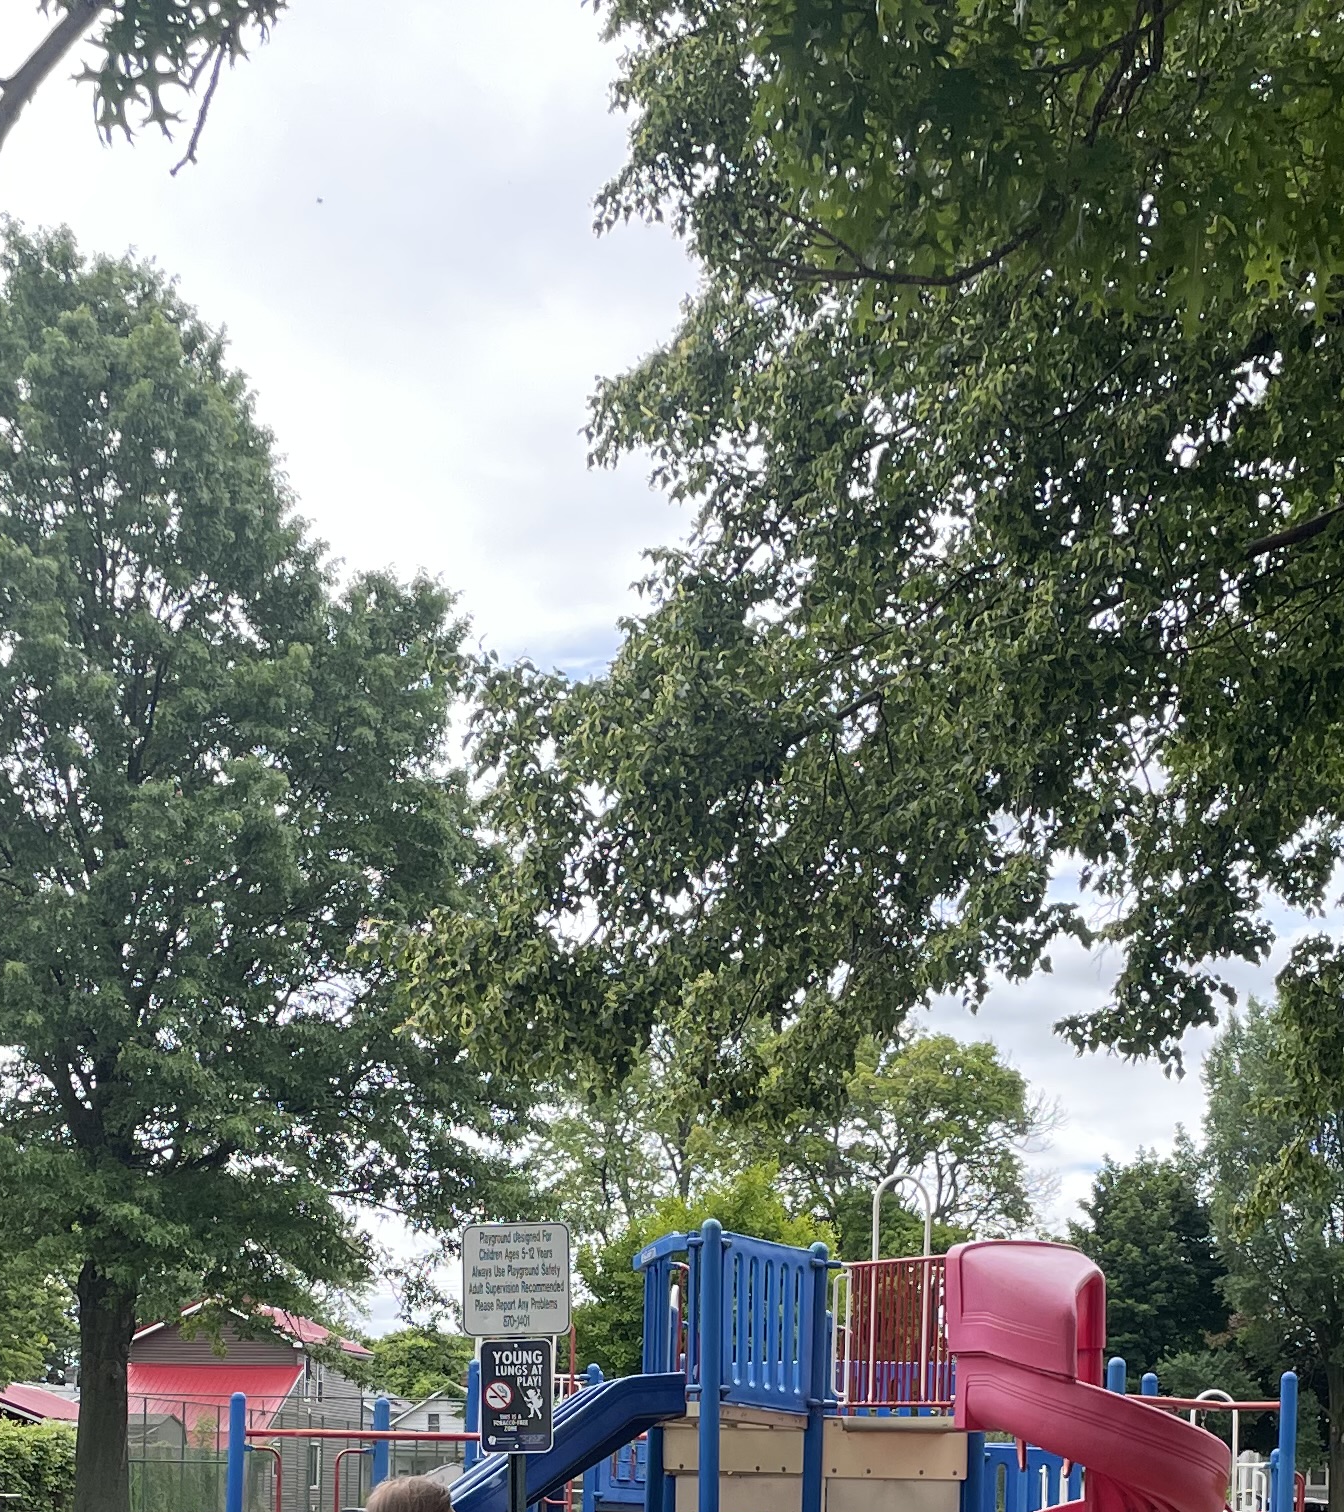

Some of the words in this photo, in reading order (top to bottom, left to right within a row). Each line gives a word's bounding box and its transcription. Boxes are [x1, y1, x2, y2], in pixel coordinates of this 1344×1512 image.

[479, 1231, 511, 1246] Playground
[542, 1230, 552, 1242] For
[479, 1249, 503, 1261] Children
[505, 1248, 520, 1262] Ages
[522, 1247, 535, 1260] 5-12
[537, 1247, 553, 1259] Years
[472, 1266, 492, 1279] Always
[494, 1265, 505, 1277] Use
[508, 1264, 539, 1279] Playground
[542, 1263, 560, 1278] Safety
[469, 1282, 484, 1295] Adult
[486, 1281, 520, 1296] Supervision
[521, 1280, 565, 1293] Recommended
[475, 1299, 494, 1312] Please
[496, 1298, 516, 1313] Report
[518, 1298, 529, 1313] Any
[531, 1297, 558, 1310] Problems
[493, 1351, 543, 1365] YOUNG
[496, 1365, 528, 1376] LUNGS
[532, 1365, 543, 1375] AT
[517, 1376, 542, 1387] PLAY!
